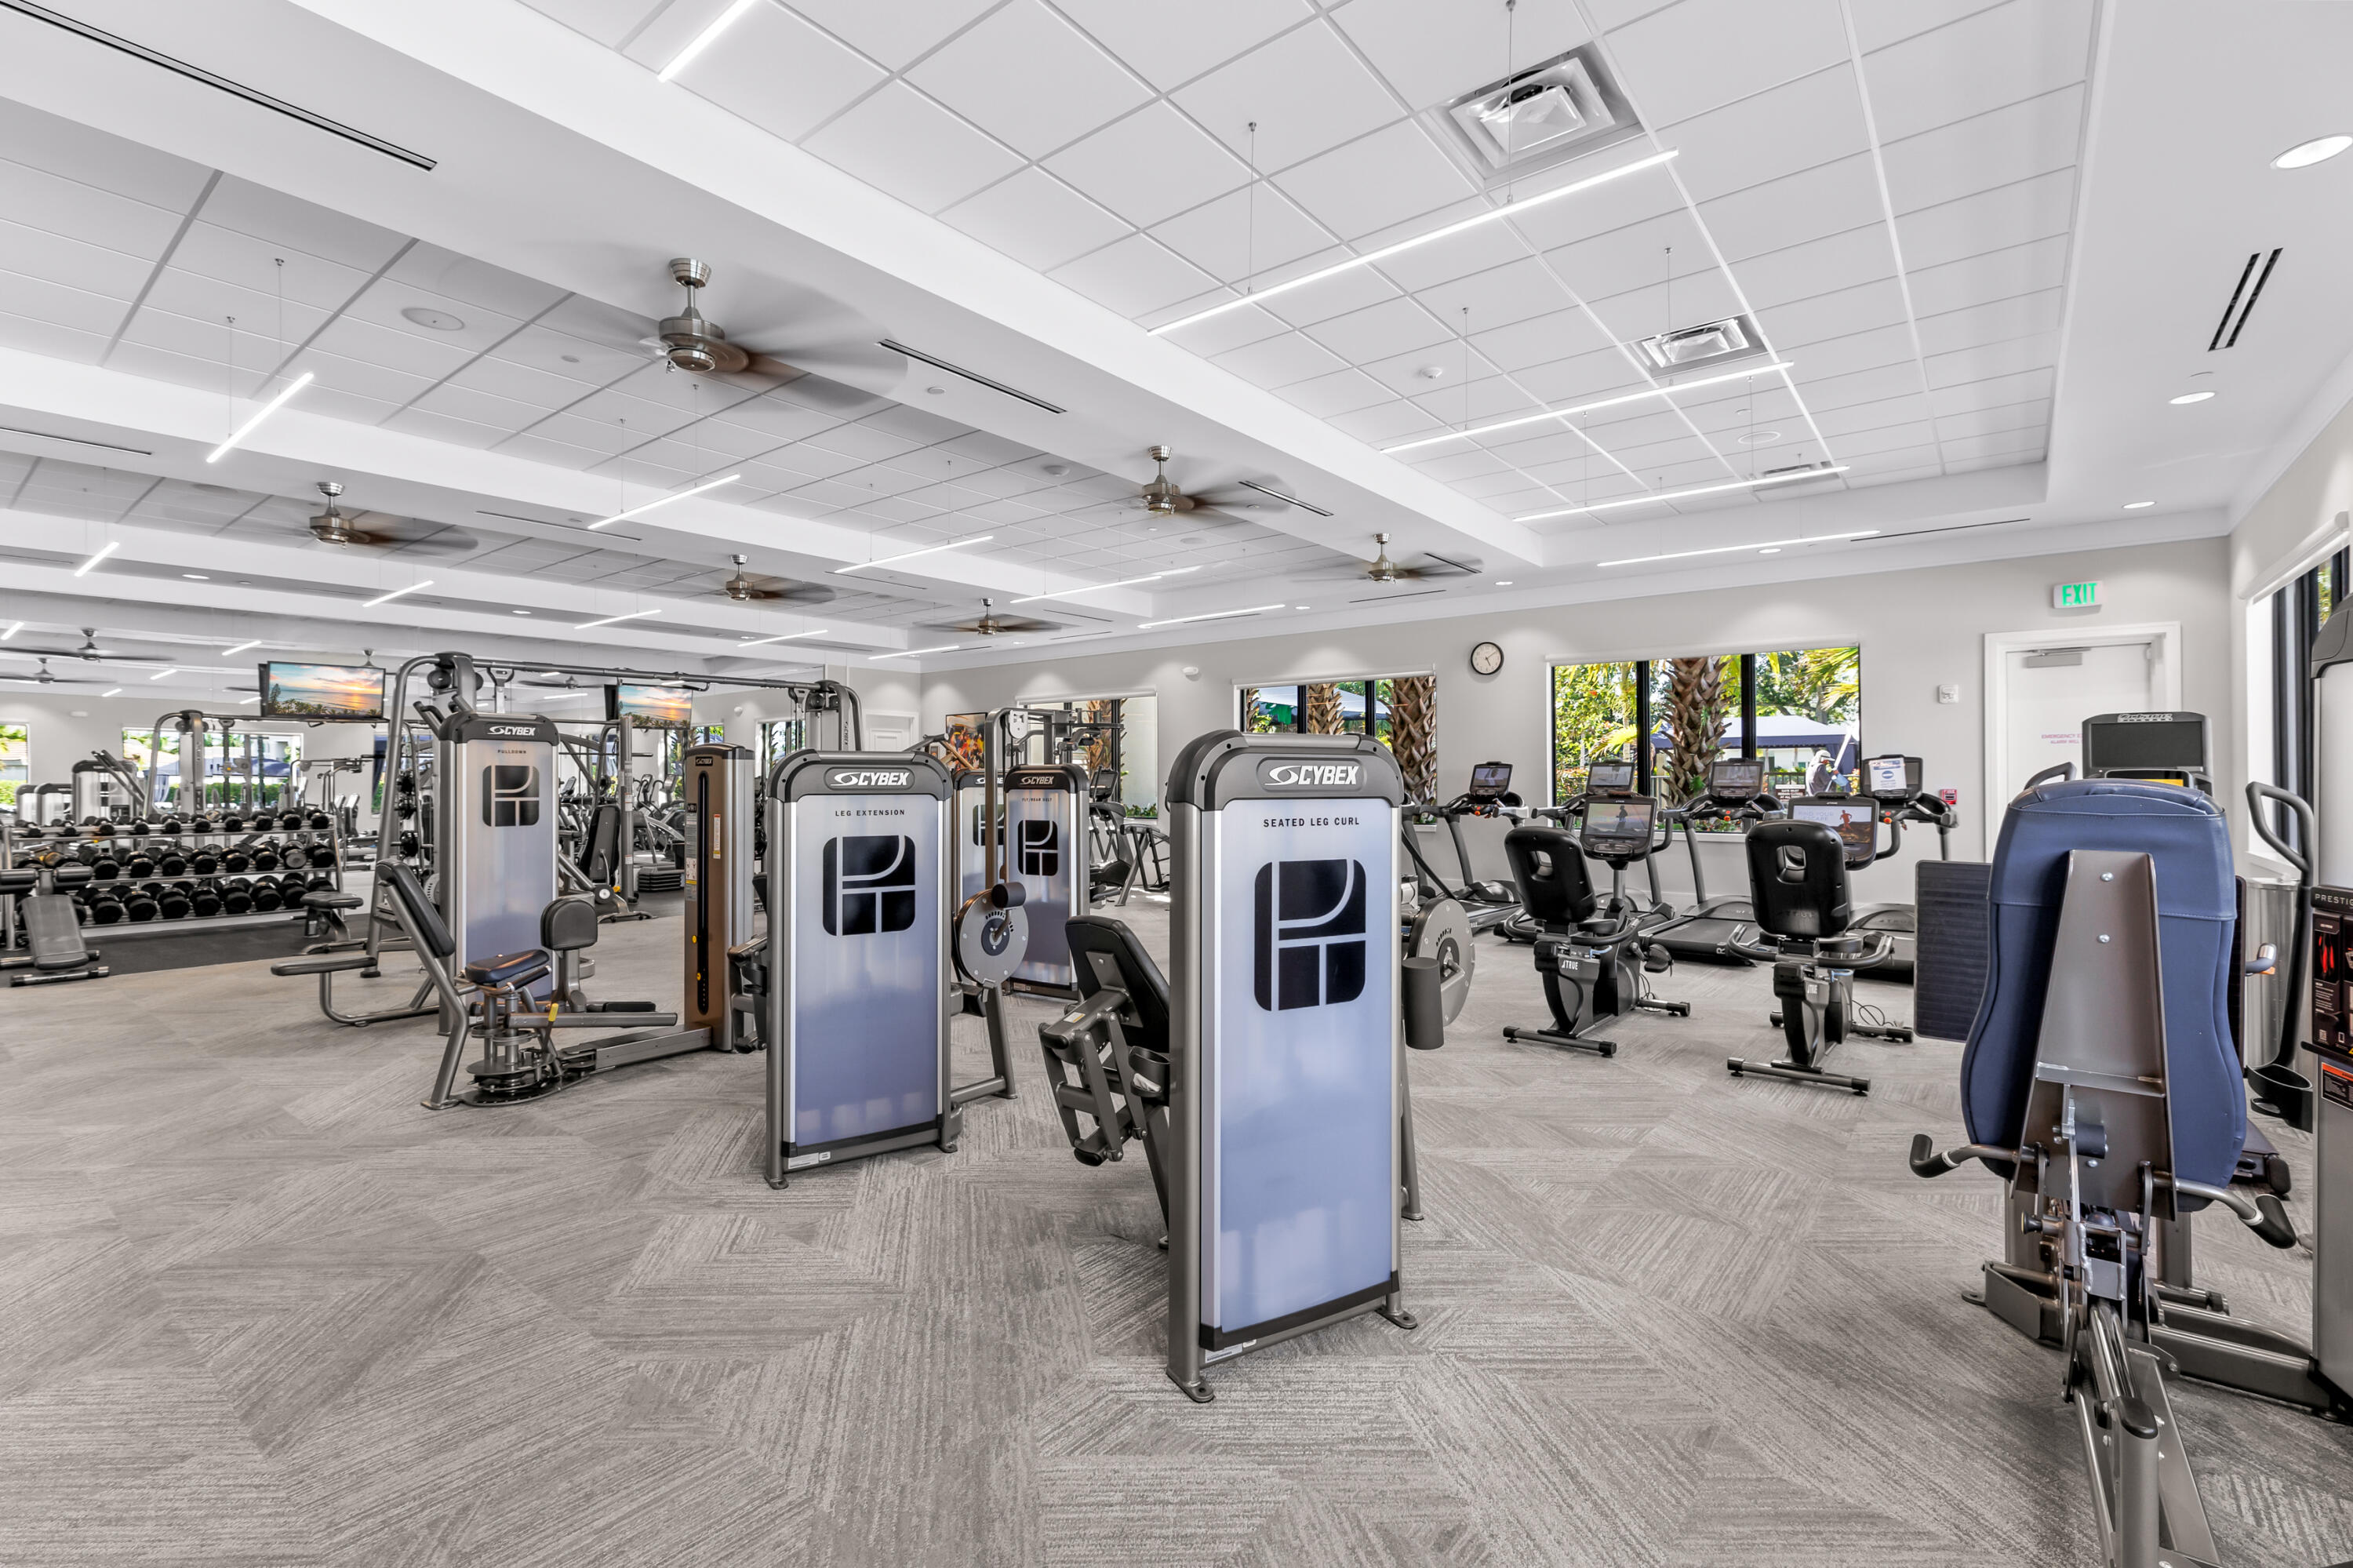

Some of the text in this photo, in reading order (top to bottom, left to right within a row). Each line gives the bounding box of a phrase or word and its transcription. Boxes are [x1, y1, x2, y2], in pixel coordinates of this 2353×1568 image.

[2062, 583, 2097, 606] EXIT
[504, 726, 536, 736] CYBEX
[857, 772, 910, 786] CYBEX
[1030, 776, 1054, 785] CYBEX
[1298, 766, 1359, 785] CYBEX
[1263, 817, 1360, 828] SEATED LEG CURL
